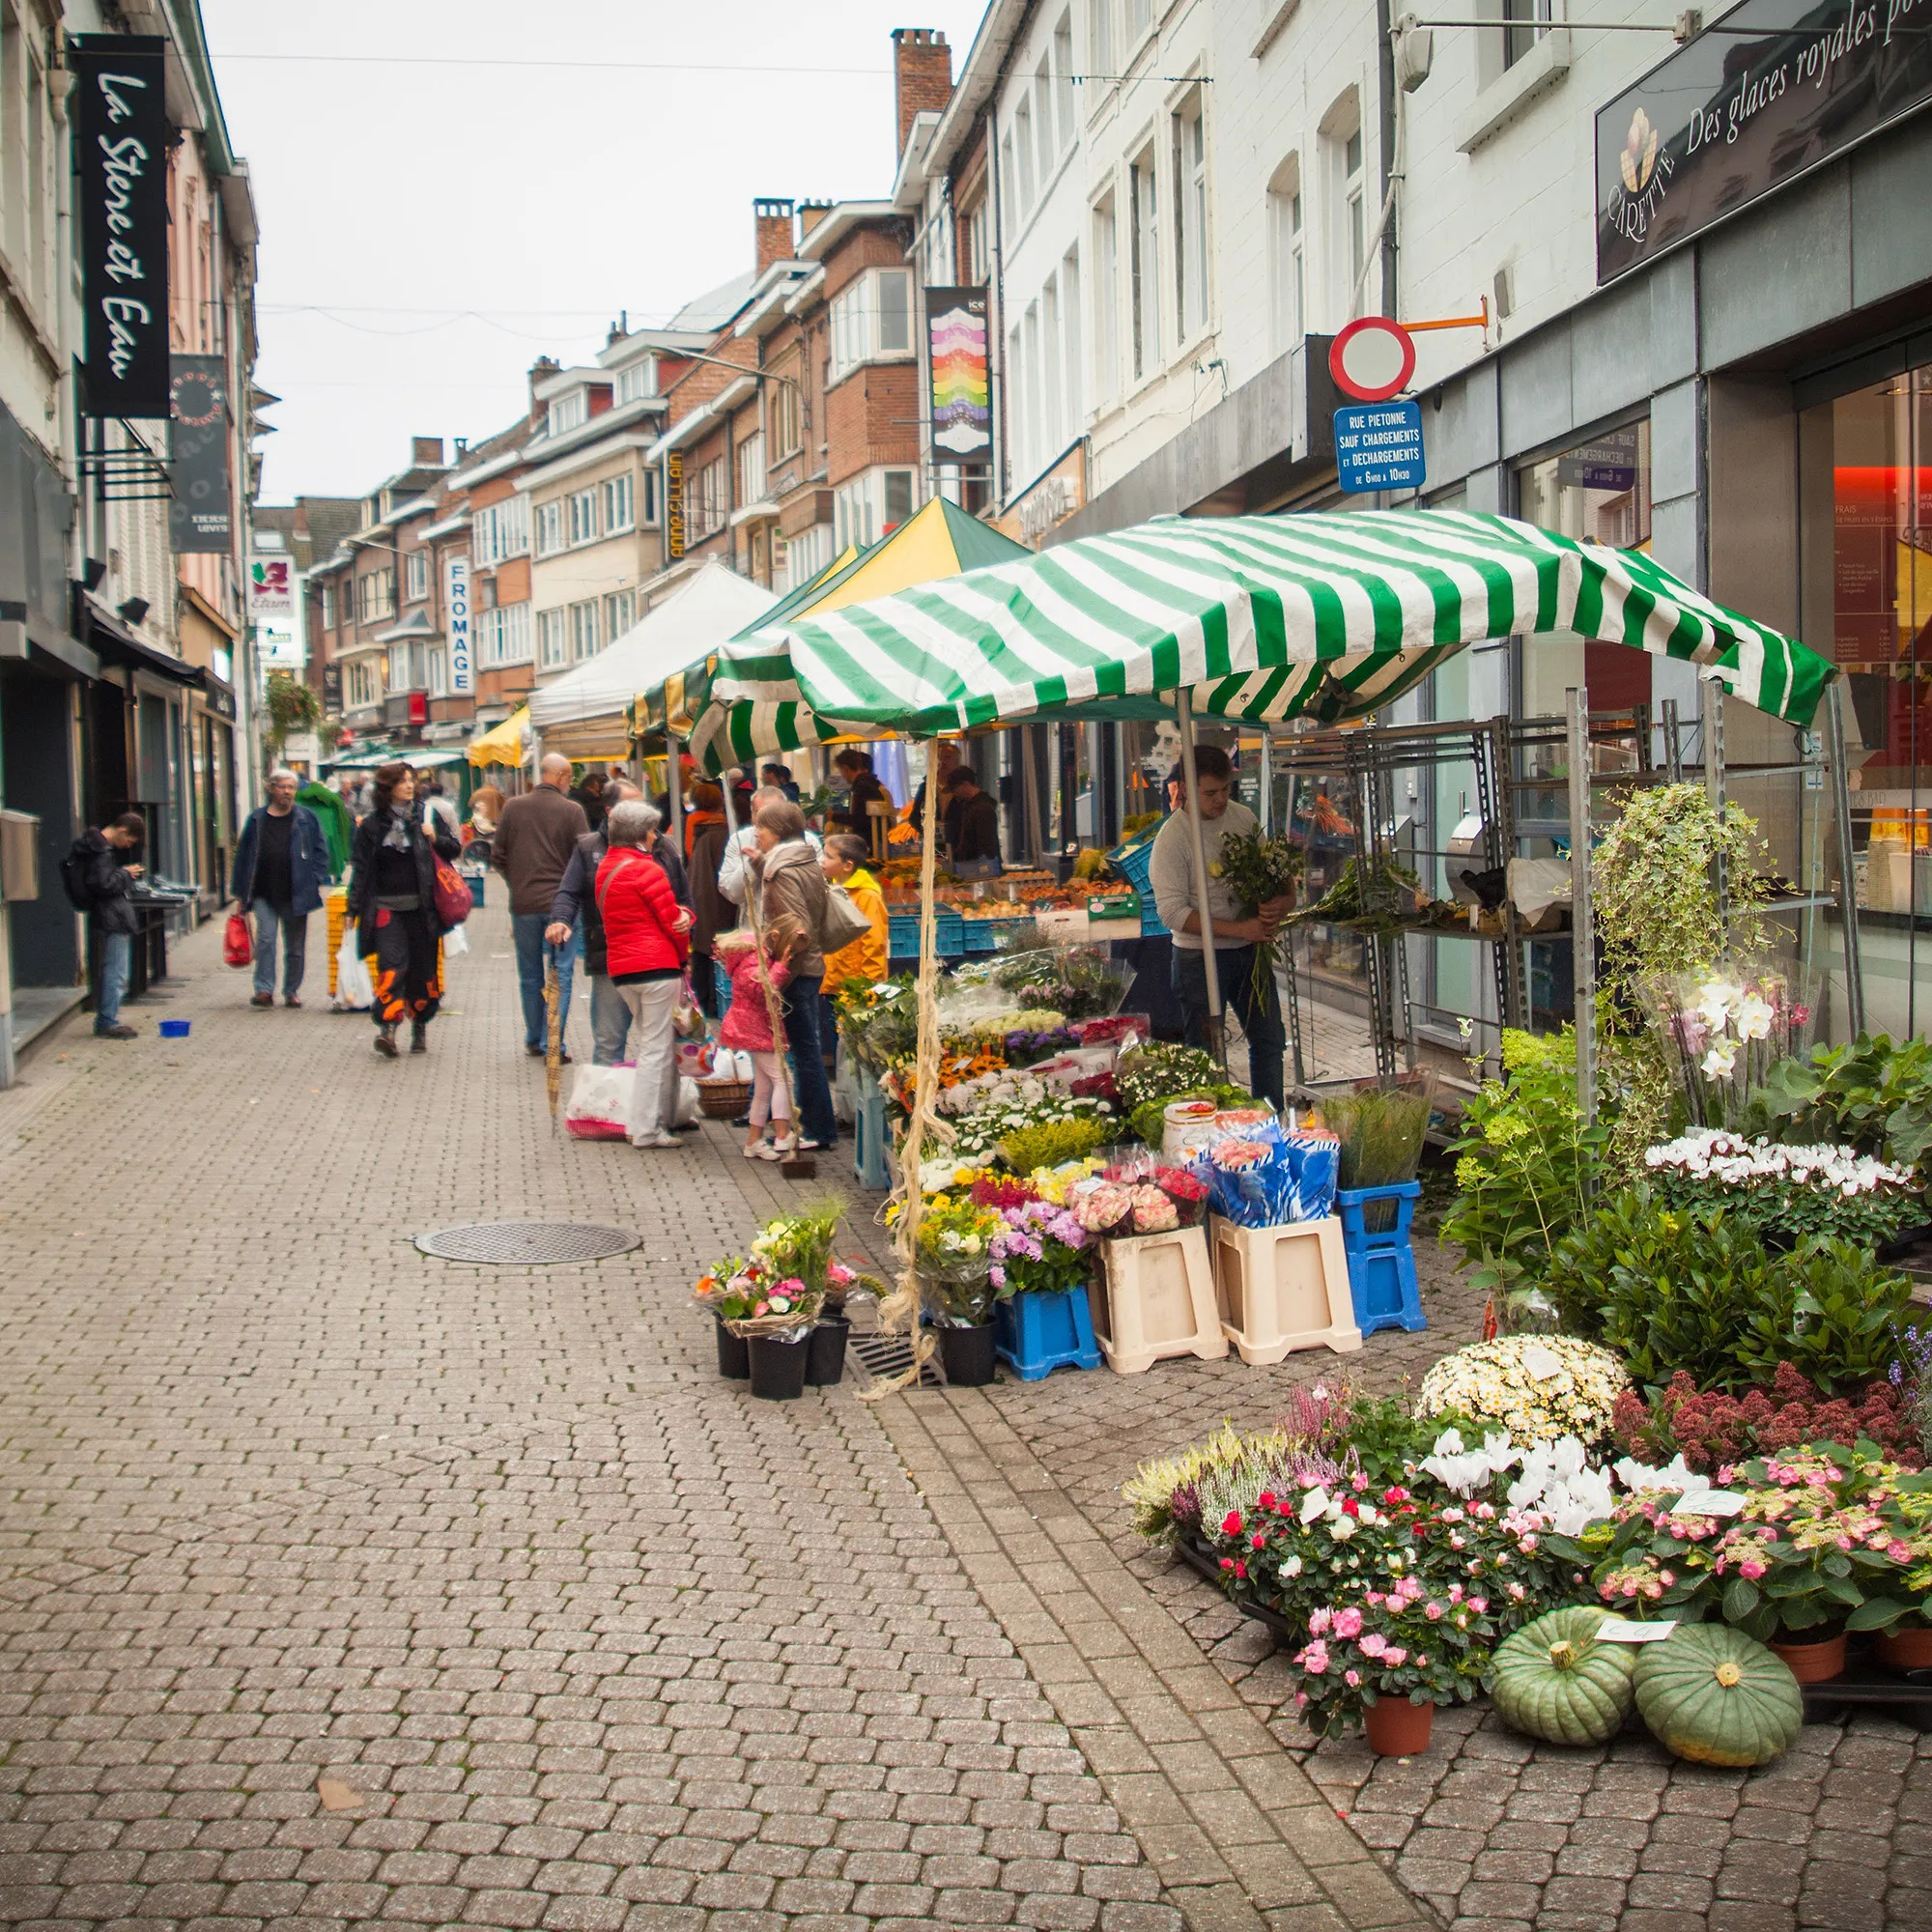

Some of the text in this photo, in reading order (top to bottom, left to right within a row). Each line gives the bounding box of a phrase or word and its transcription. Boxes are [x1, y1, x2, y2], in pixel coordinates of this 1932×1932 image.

[1686, 0, 1923, 156] Des glaces royales po
[1607, 146, 1676, 242] CARETTE
[98, 72, 152, 380] La Stere et Eau
[968, 298, 985, 309] ice
[1349, 412, 1406, 429] RUE PIETONNE
[1339, 429, 1420, 449] SAUF CHARGEMENTS
[1343, 447, 1420, 468] ET DECHARGEMENTS
[1355, 476, 1363, 485] DE
[1835, 505, 1856, 514] FRAIS
[451, 565, 469, 689] FROMAGE
